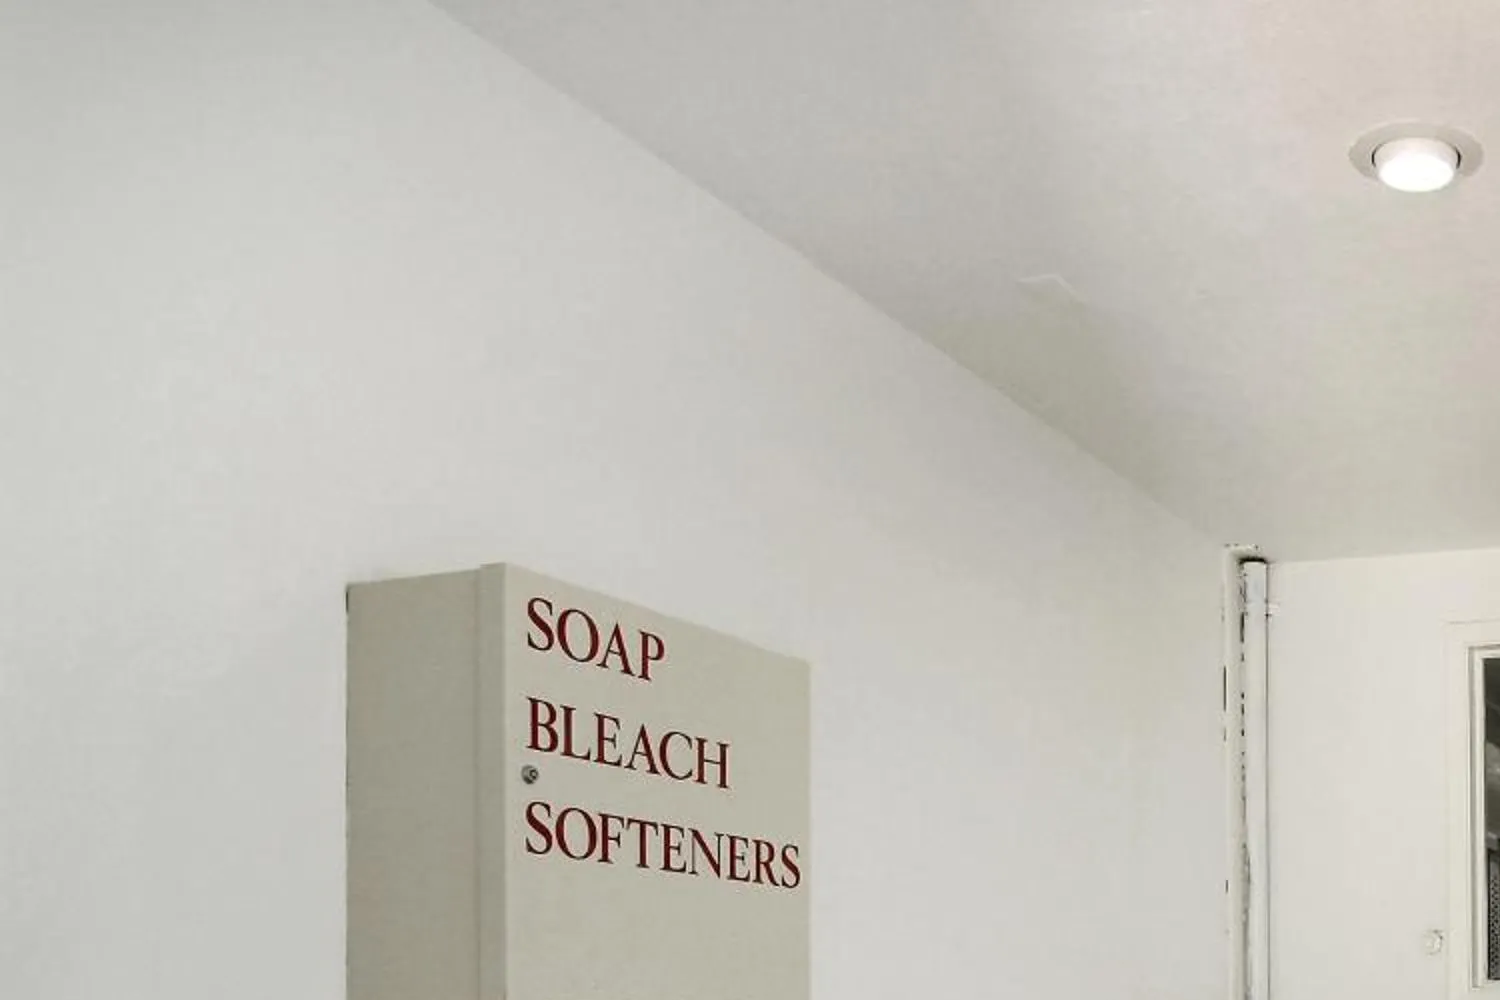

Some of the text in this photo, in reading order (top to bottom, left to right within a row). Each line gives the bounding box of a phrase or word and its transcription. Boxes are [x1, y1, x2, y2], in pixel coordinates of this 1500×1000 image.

[527, 597, 666, 682] SOAP
[525, 696, 731, 788] BLEACH
[525, 801, 801, 889] SOFTENERS
